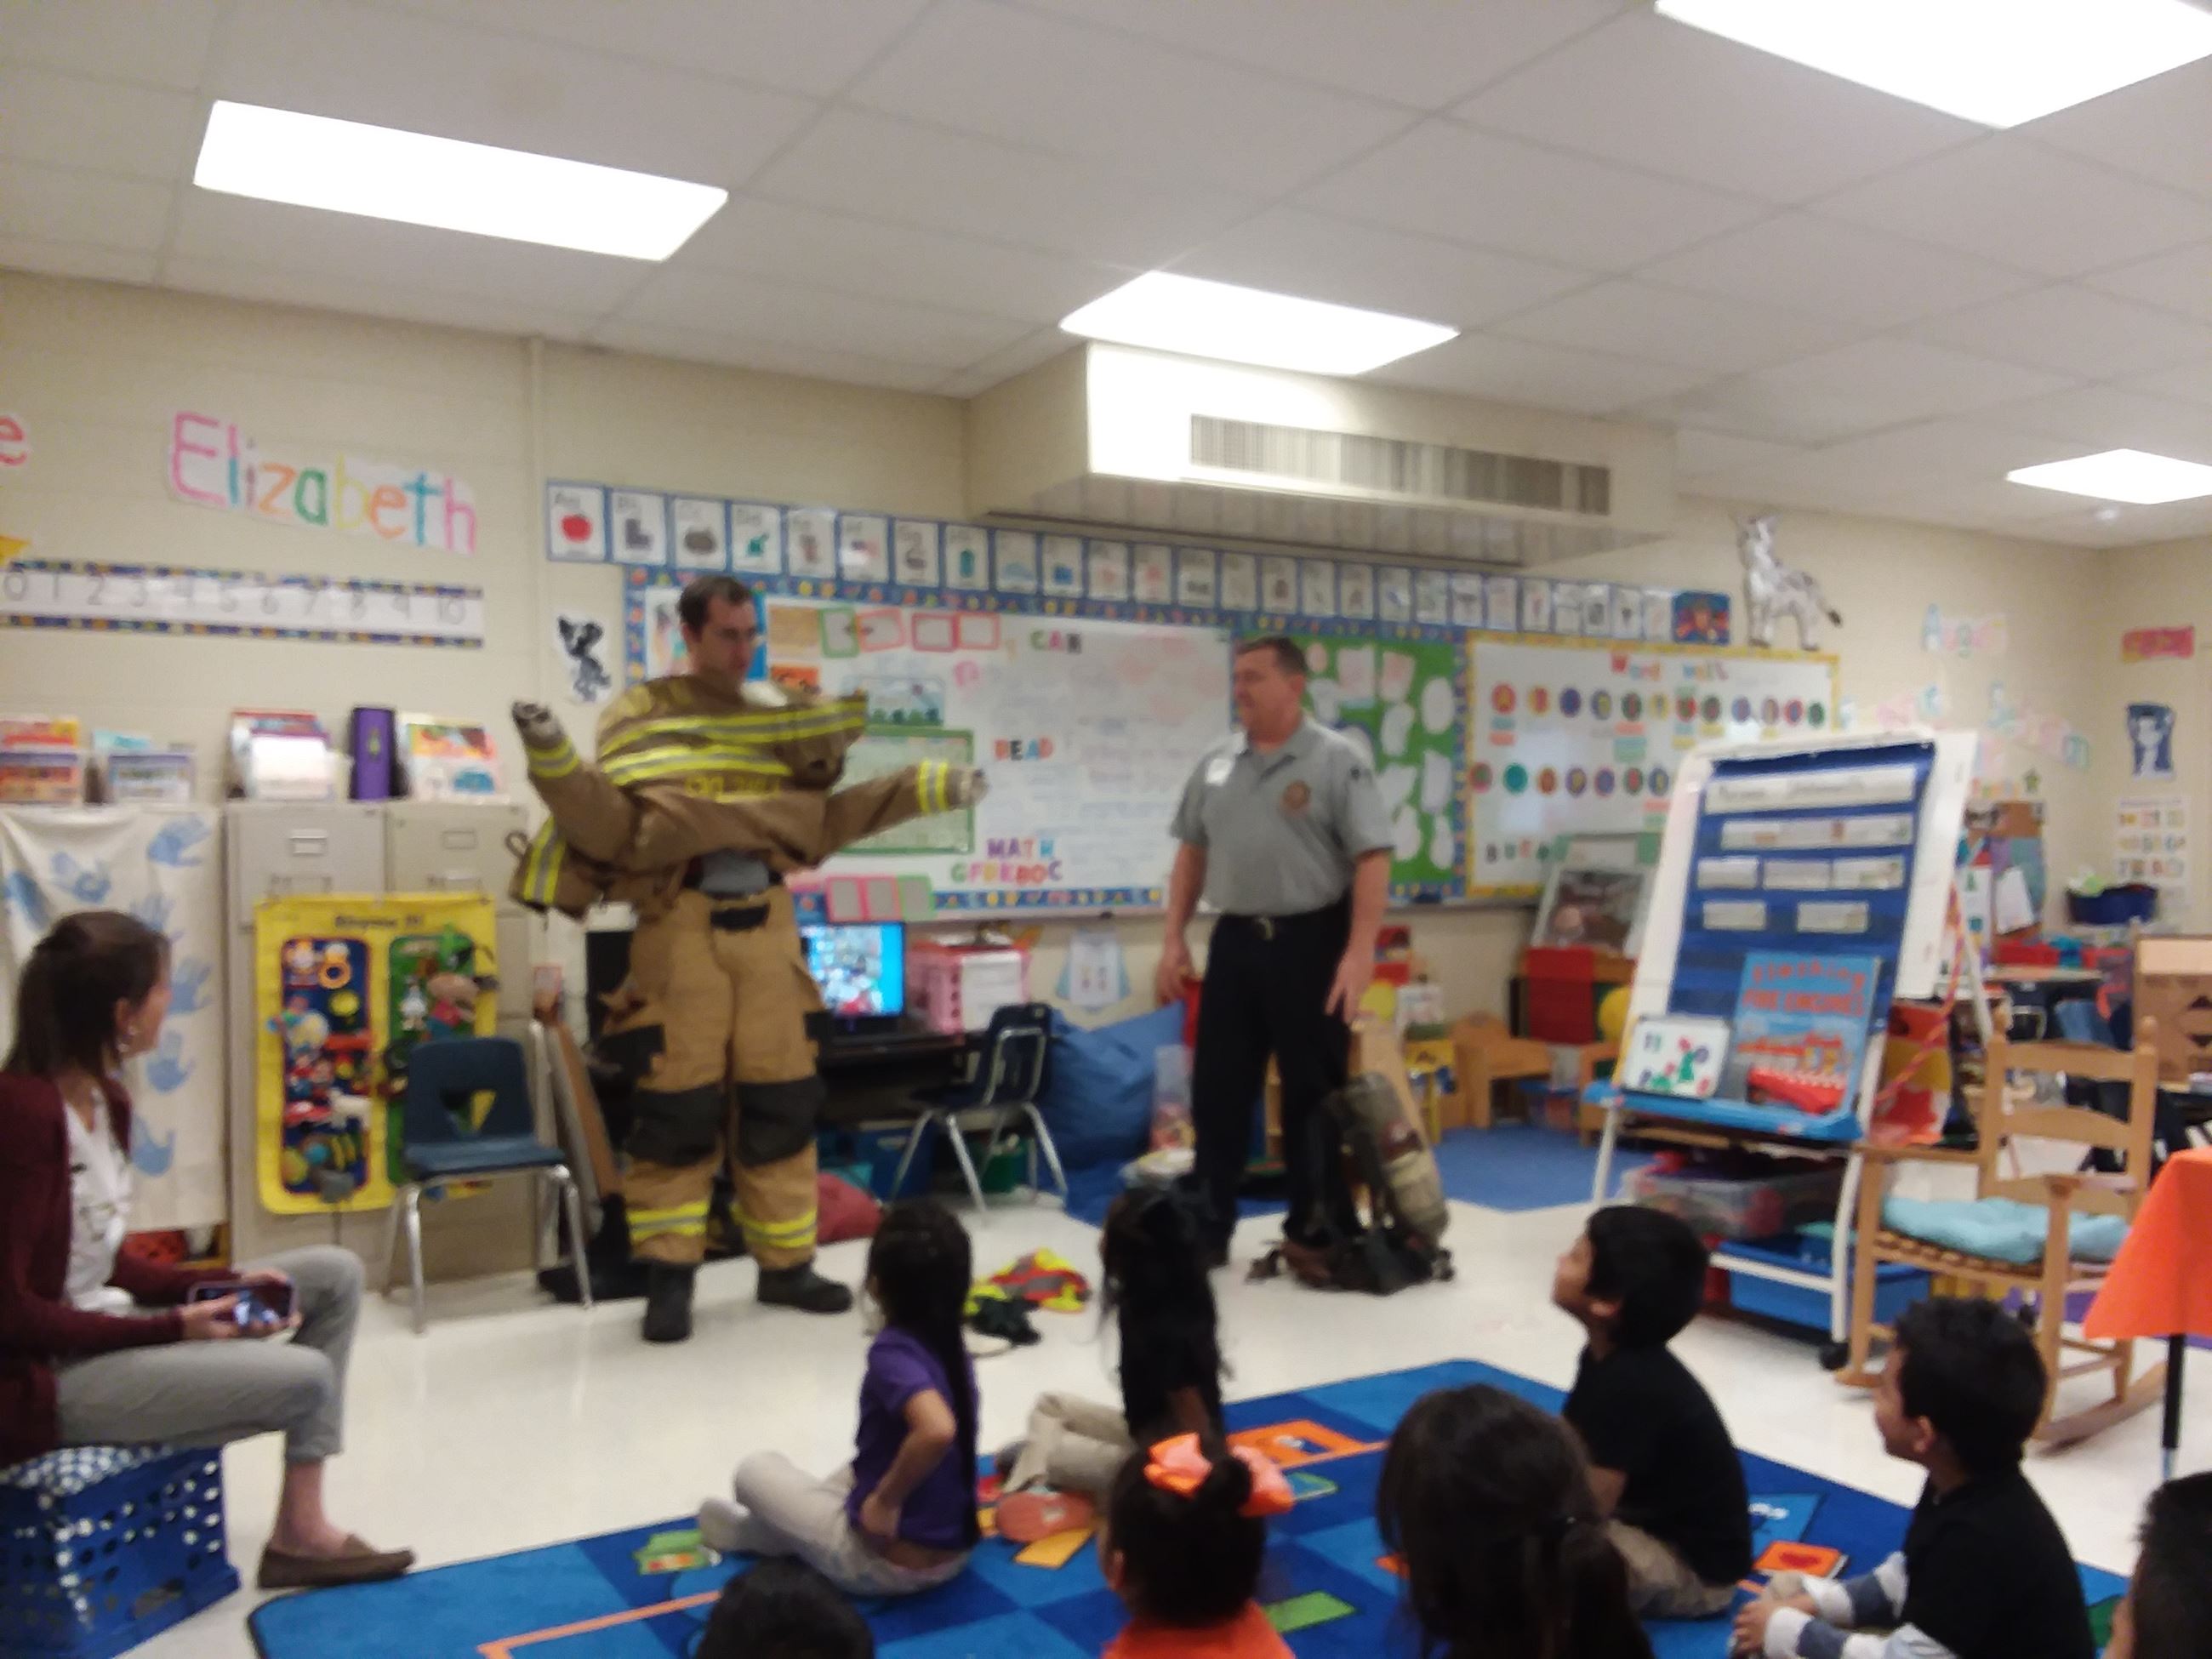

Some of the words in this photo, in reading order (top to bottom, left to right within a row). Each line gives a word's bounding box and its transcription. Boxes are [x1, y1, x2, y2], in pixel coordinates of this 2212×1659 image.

[171, 411, 476, 555] Elizabeth
[87, 575, 106, 606] 2
[437, 597, 467, 625] 10
[993, 738, 1055, 761] READ
[986, 837, 1055, 858] MATH
